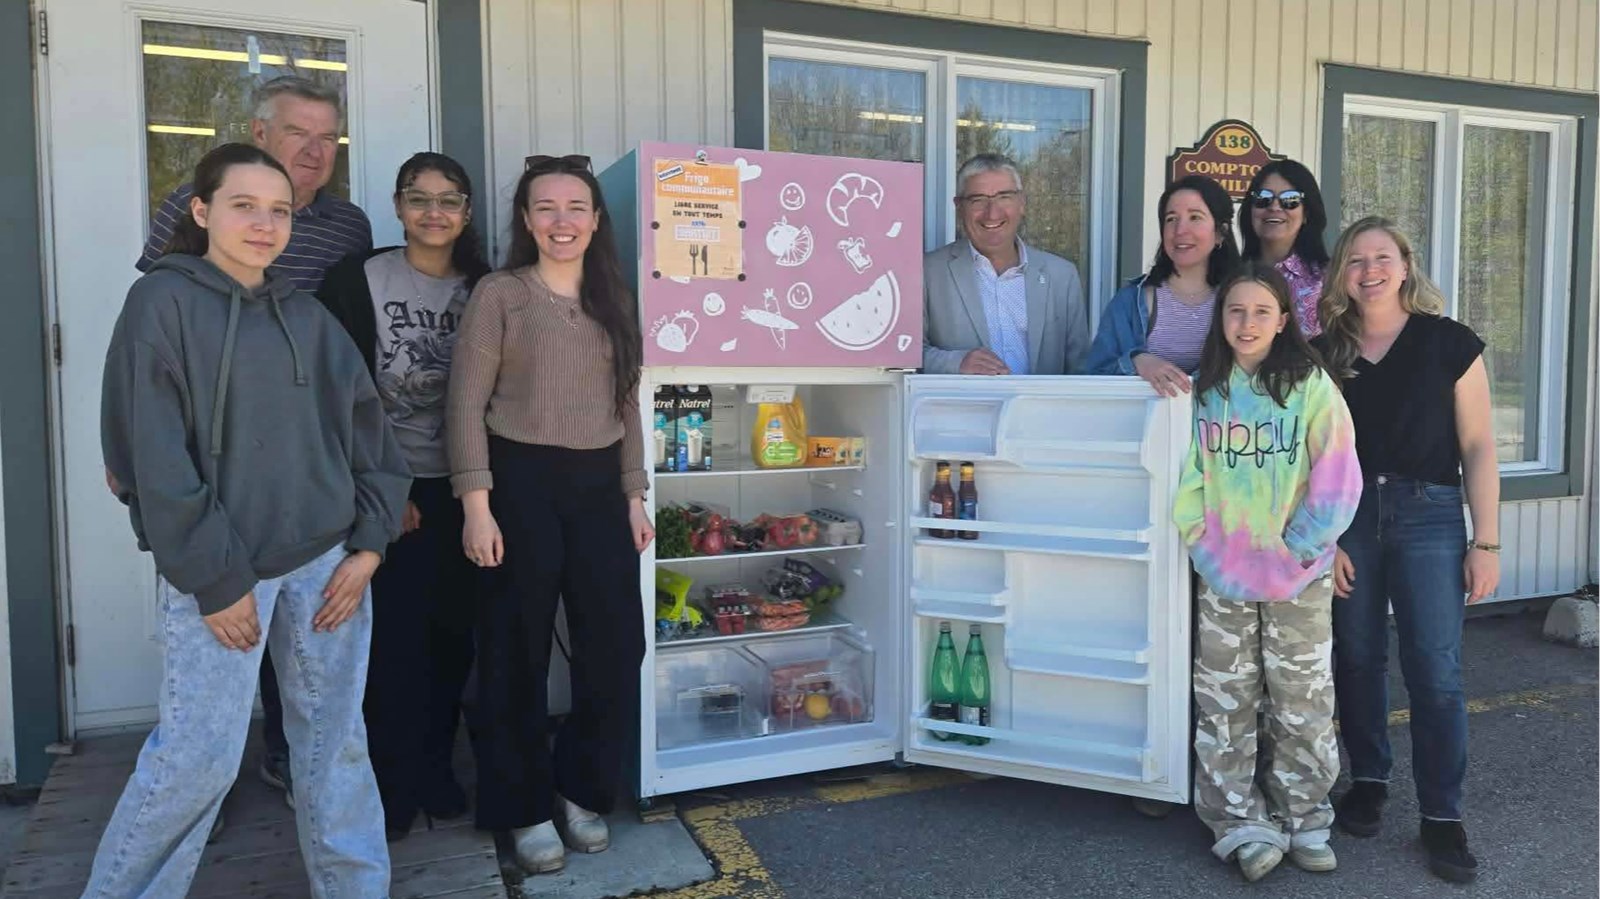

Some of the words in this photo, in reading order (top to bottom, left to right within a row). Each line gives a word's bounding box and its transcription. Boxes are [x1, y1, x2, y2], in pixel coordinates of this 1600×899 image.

[1218, 135, 1251, 149] 138
[1185, 160, 1262, 177] COMPTO
[684, 171, 709, 185] Frigo
[674, 201, 692, 209] LIBRE
[694, 202, 719, 210] SERVICE
[383, 300, 462, 336] Ang
[679, 398, 711, 409] Natrel
